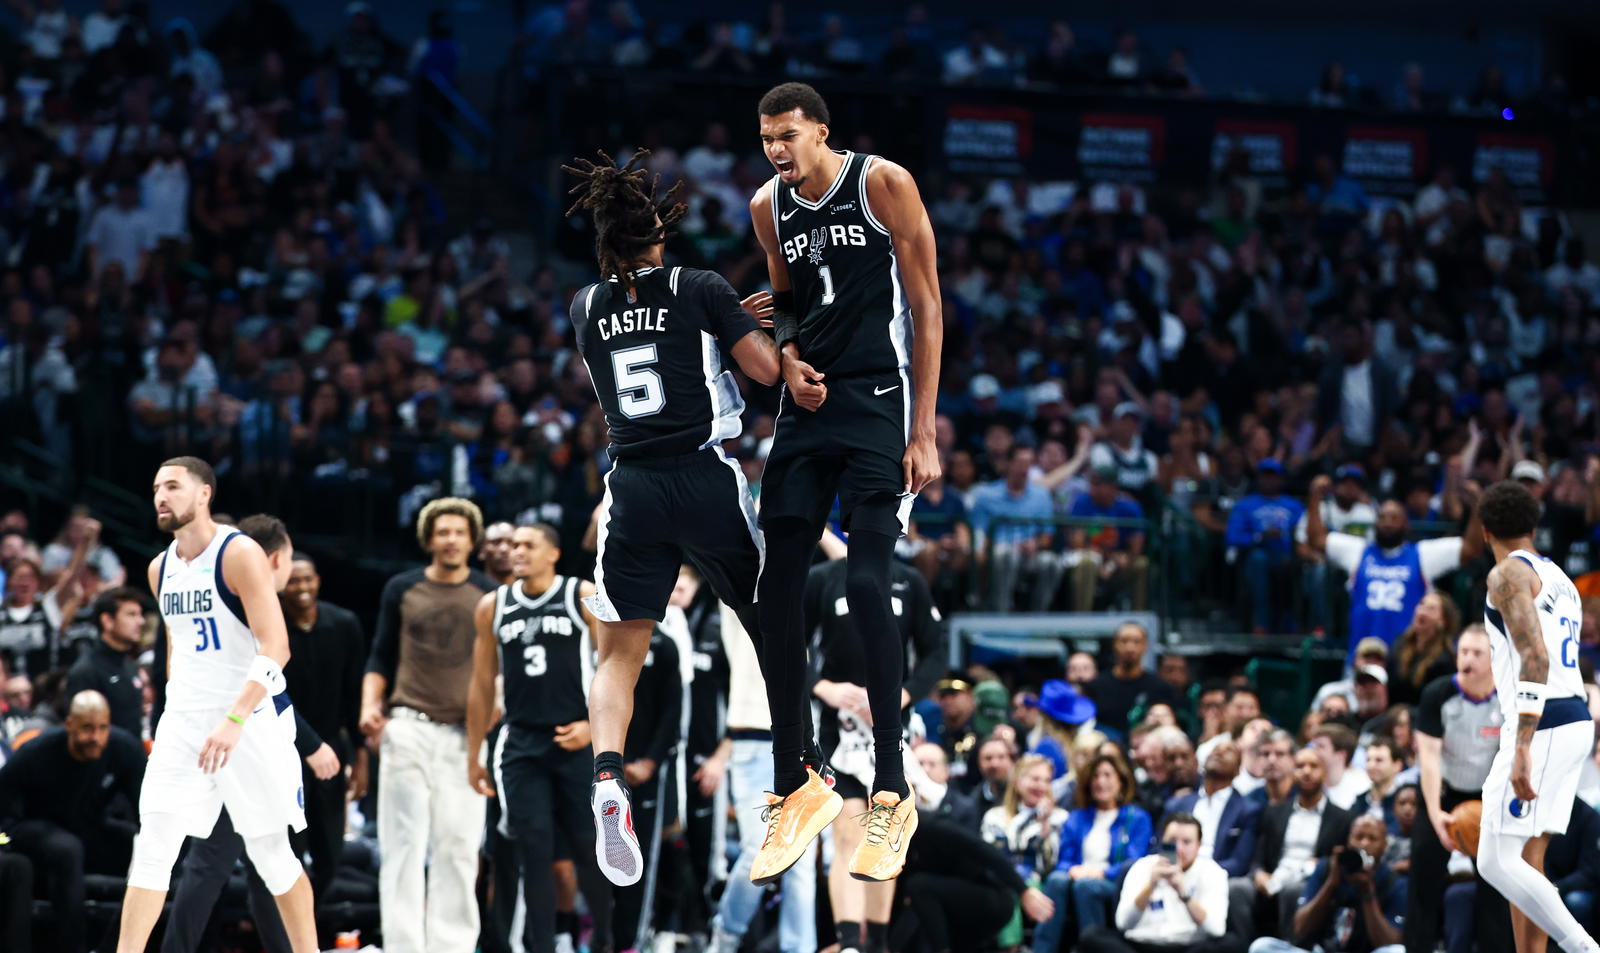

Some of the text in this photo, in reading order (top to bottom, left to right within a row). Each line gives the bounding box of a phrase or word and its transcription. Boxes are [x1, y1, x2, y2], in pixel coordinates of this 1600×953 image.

[783, 224, 867, 264] SPURS
[817, 264, 836, 306] 1
[597, 307, 668, 341] CASTLE
[610, 342, 667, 420] 5
[163, 588, 213, 616] DALLAS
[1366, 579, 1406, 612] 32
[192, 616, 222, 652] 31
[523, 644, 547, 677] 3
